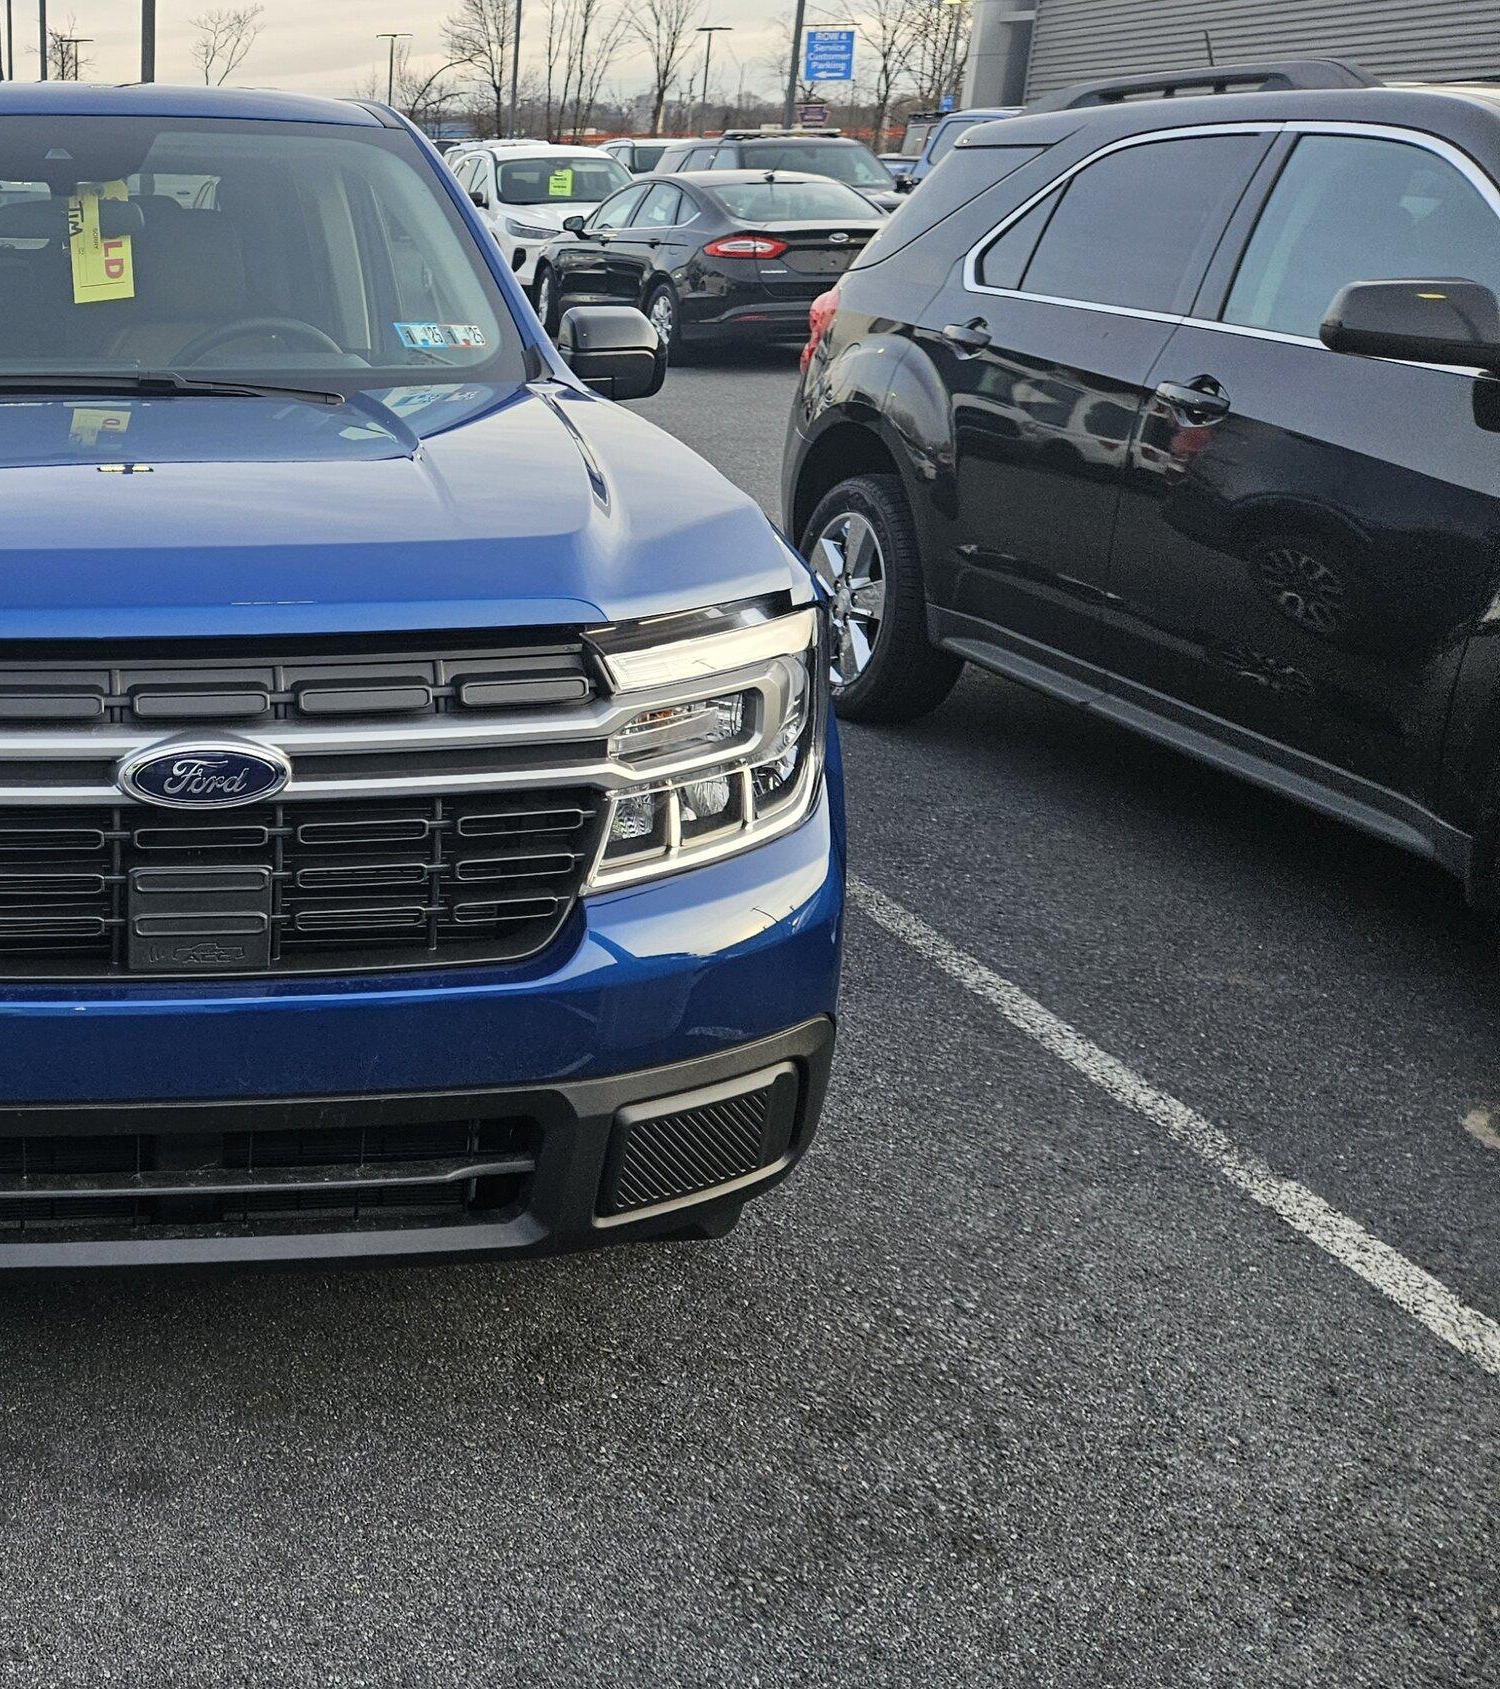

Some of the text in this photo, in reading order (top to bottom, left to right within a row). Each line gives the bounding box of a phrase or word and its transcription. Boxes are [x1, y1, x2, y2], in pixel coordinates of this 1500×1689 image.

[813, 44, 846, 52] Service
[808, 52, 851, 61] Customer
[811, 62, 846, 71] Parking
[103, 241, 124, 279] LD
[163, 759, 249, 794] Ford
